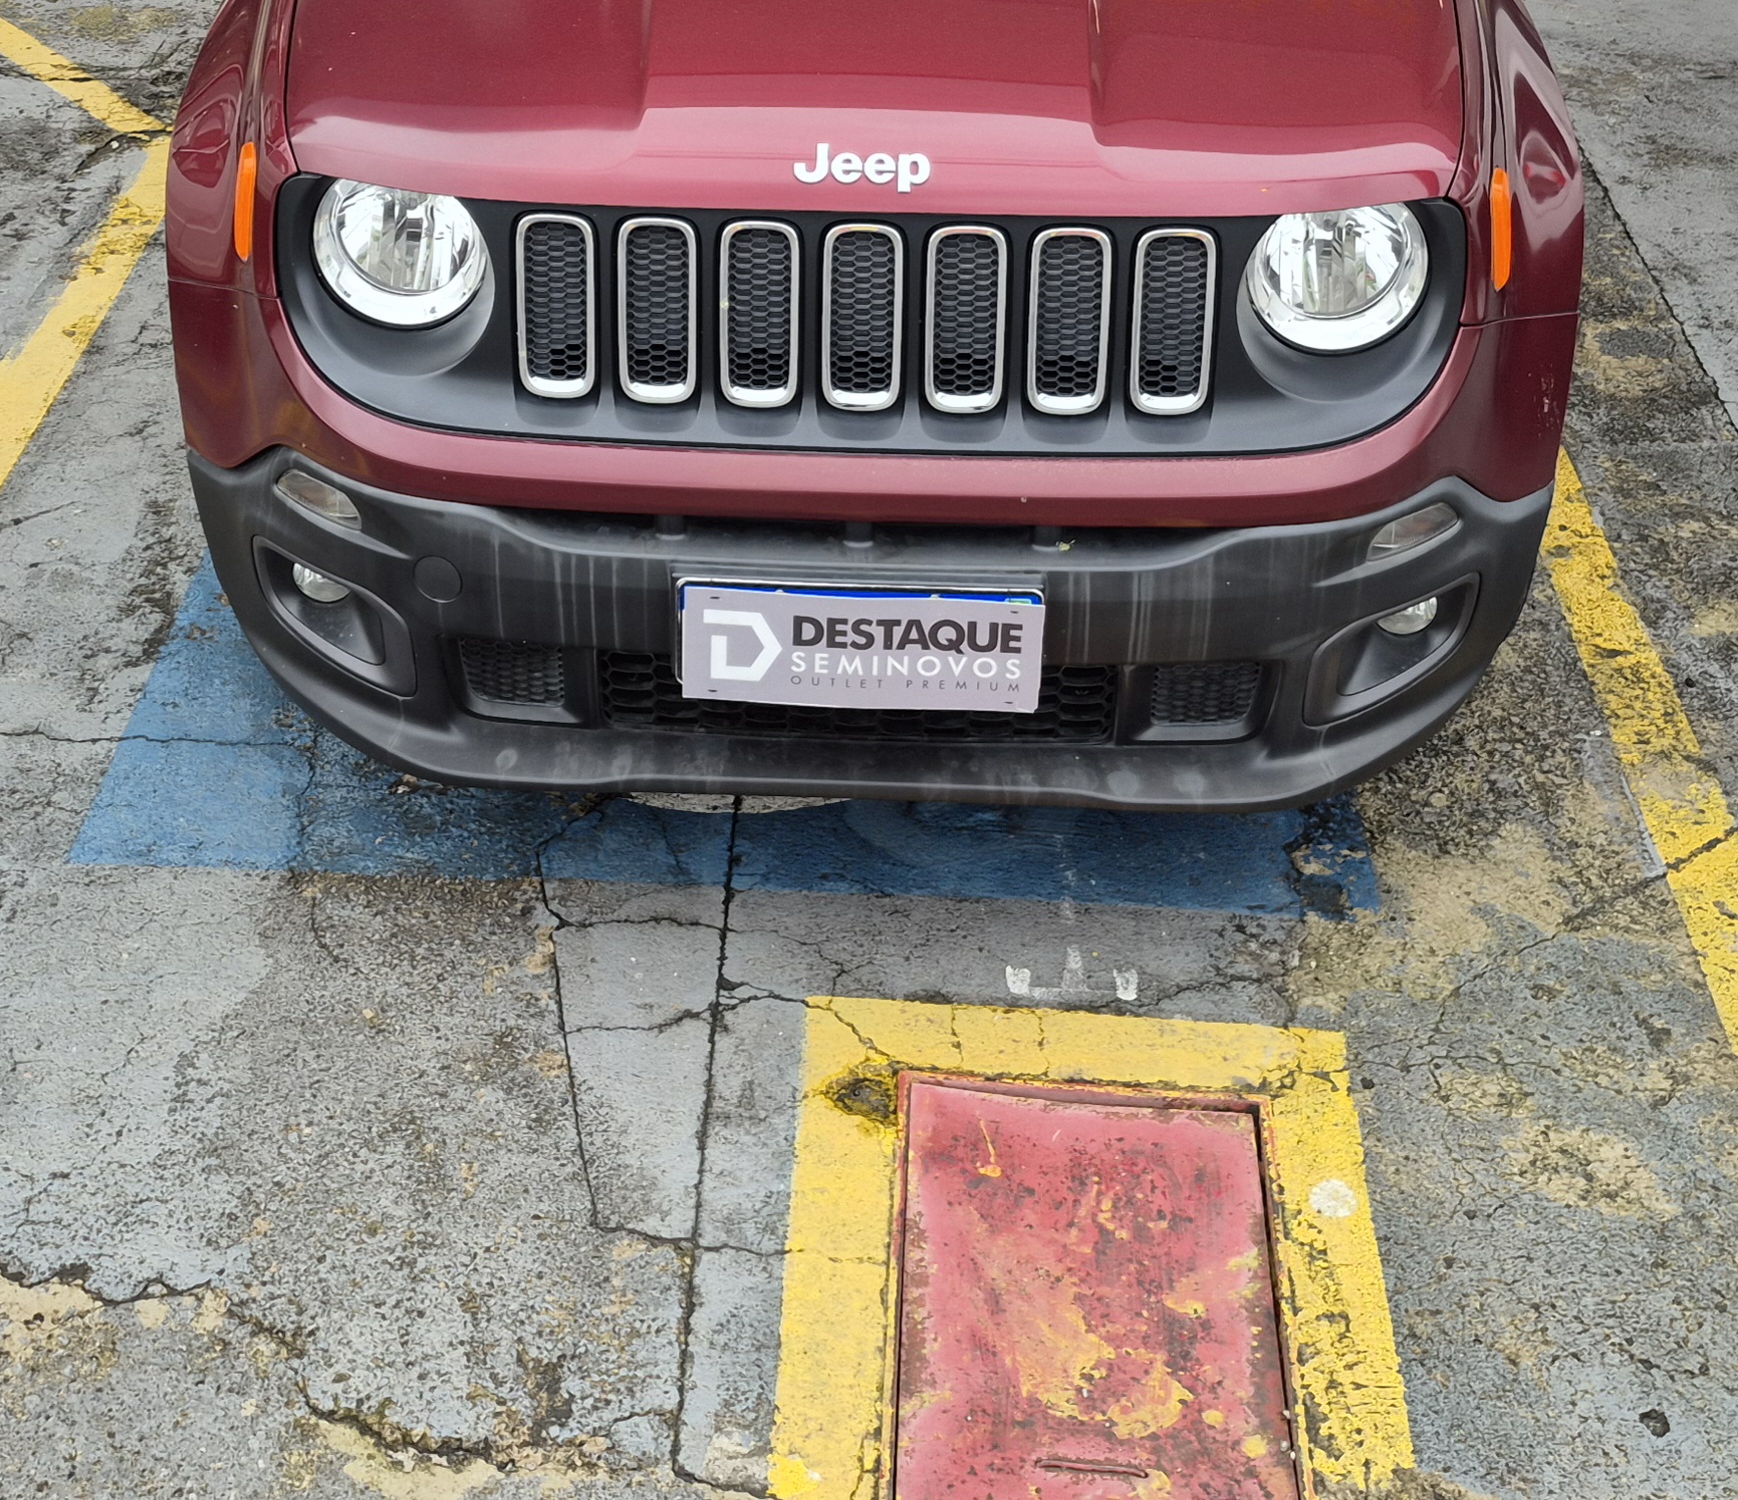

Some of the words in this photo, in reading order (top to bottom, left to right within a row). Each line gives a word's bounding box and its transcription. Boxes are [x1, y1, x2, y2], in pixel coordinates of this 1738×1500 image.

[793, 143, 932, 193] Jeep
[792, 614, 1024, 655] DESTAQUE
[790, 651, 1022, 679] SEMINOVOS
[790, 674, 885, 690] OUTLET
[906, 678, 1021, 693] PREMIUM
